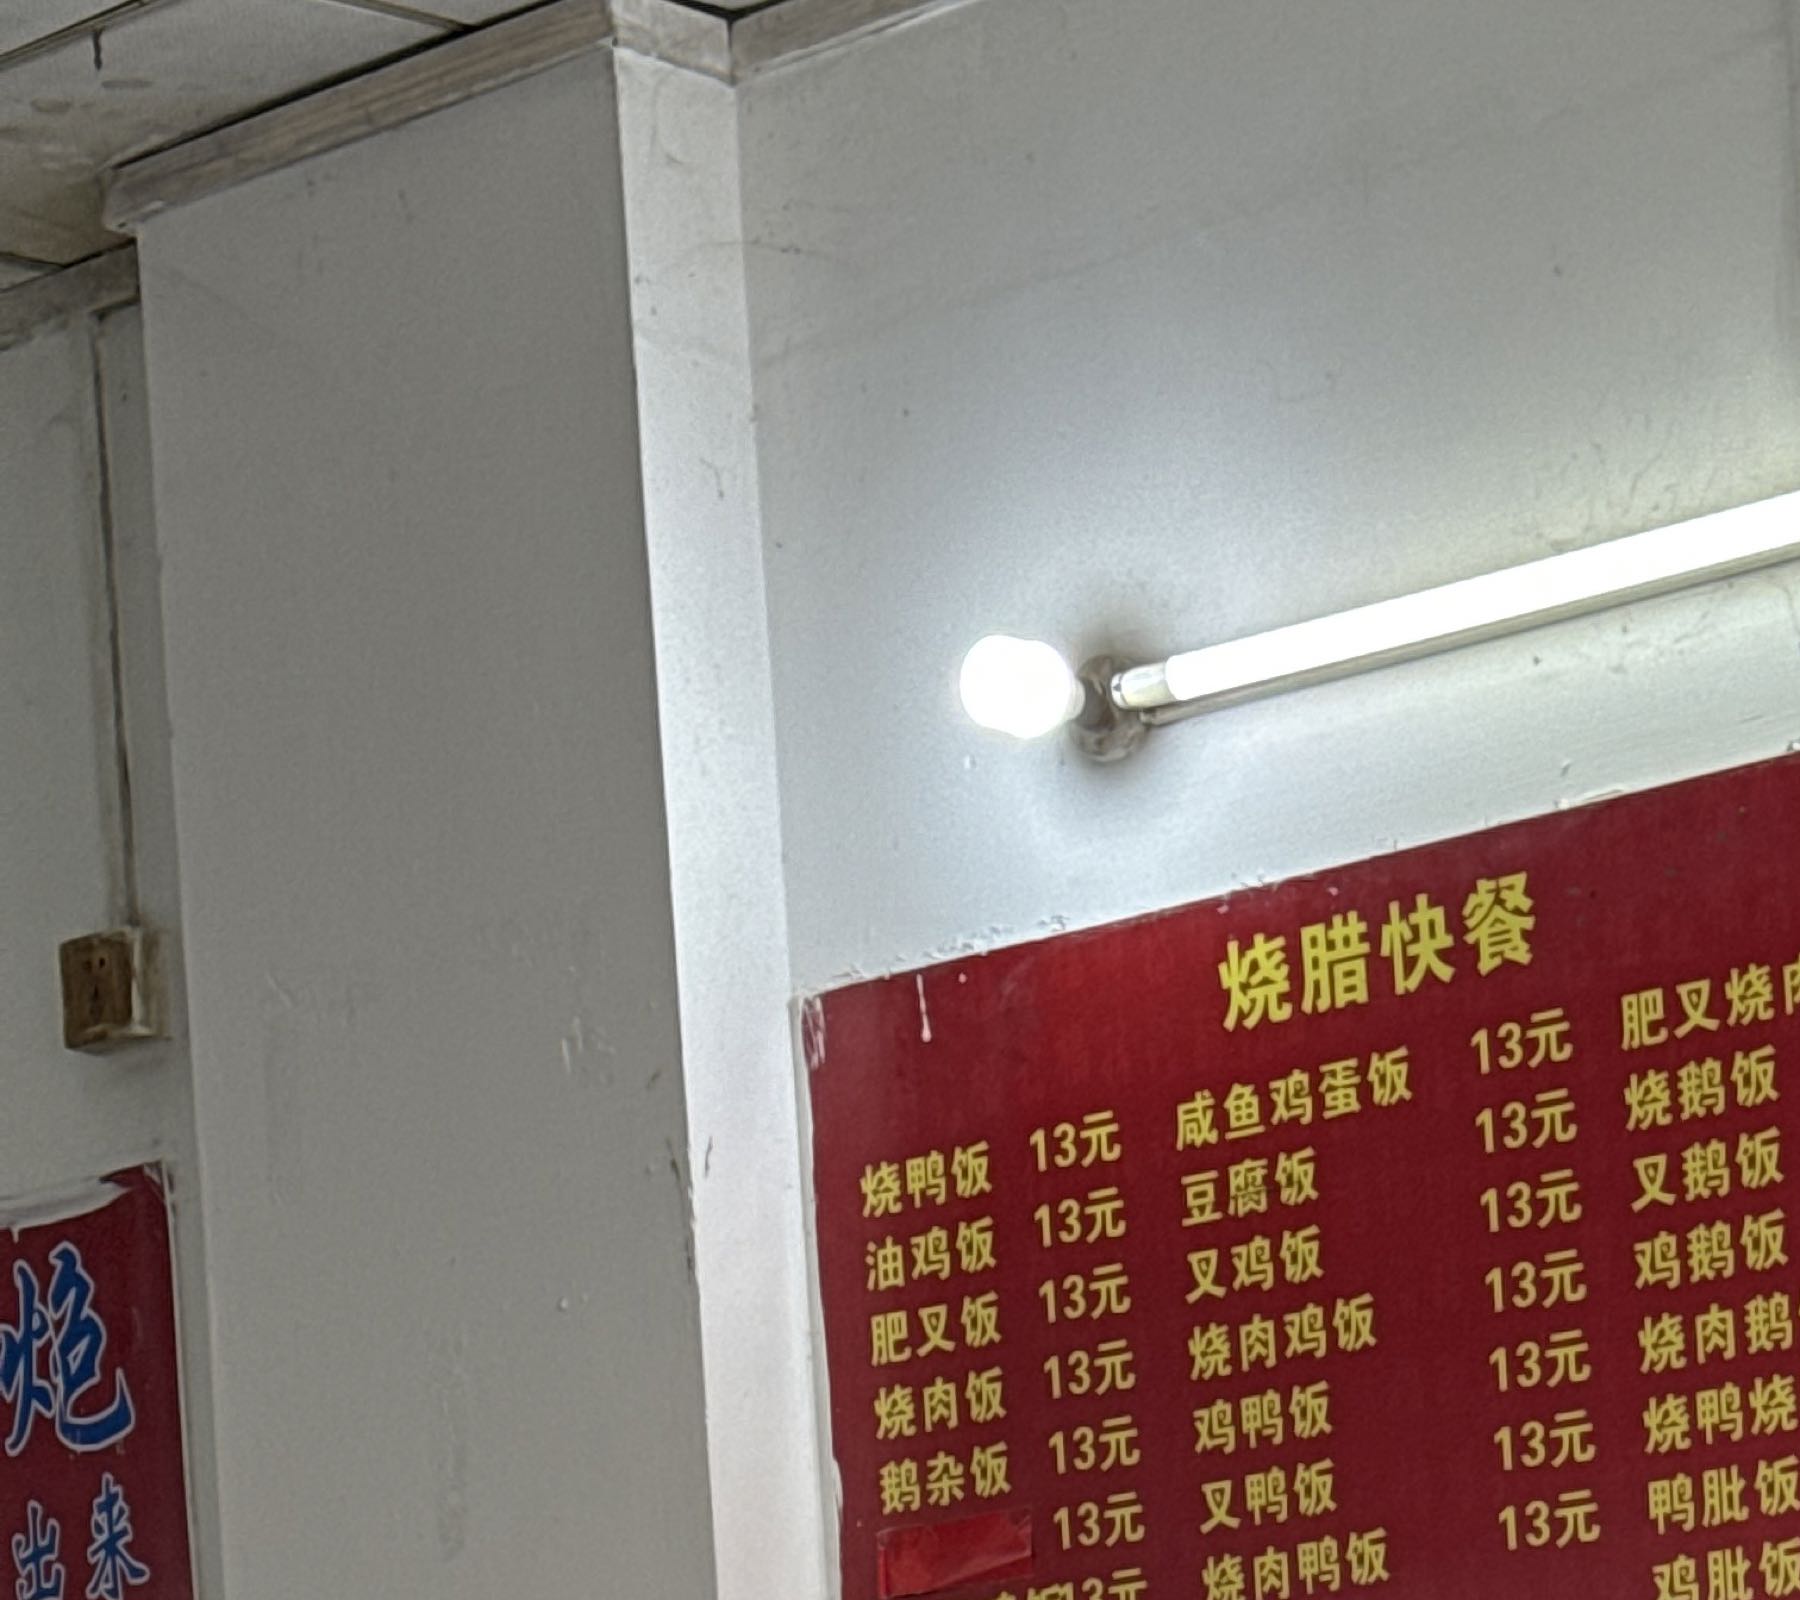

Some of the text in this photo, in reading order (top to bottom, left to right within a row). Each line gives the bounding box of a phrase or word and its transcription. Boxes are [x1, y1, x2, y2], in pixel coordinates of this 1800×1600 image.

[1217, 871, 1536, 1031] 烧腊快餐
[1176, 1007, 1573, 1150] 咸鱼鸡蛋饭 13元
[1623, 1045, 1779, 1130] 烧鹅饭
[860, 1110, 1121, 1217] 烧鸭饭 13元
[1181, 1088, 1577, 1226] 豆腐饭 13元
[1632, 1126, 1784, 1211] 叉鹅饭
[865, 1186, 1126, 1291] 油鸡饭 13元
[1187, 1168, 1582, 1303] 叉鸡饭 13元
[1634, 1209, 1788, 1289] 鸡鹅饭
[870, 1263, 1131, 1366] 肥叉饭 13元
[1188, 1249, 1587, 1380] 烧肉鸡饭 13元
[873, 1339, 1136, 1440] 烧肉饭 13元
[1193, 1329, 1591, 1454] 鸡鸭饭 13元
[879, 1416, 1140, 1514] 鹅杂饭 13元
[1200, 1409, 1596, 1533] 叉鸭饭 13元
[1054, 1492, 1145, 1547] 13元
[1498, 1489, 1601, 1549] 13元
